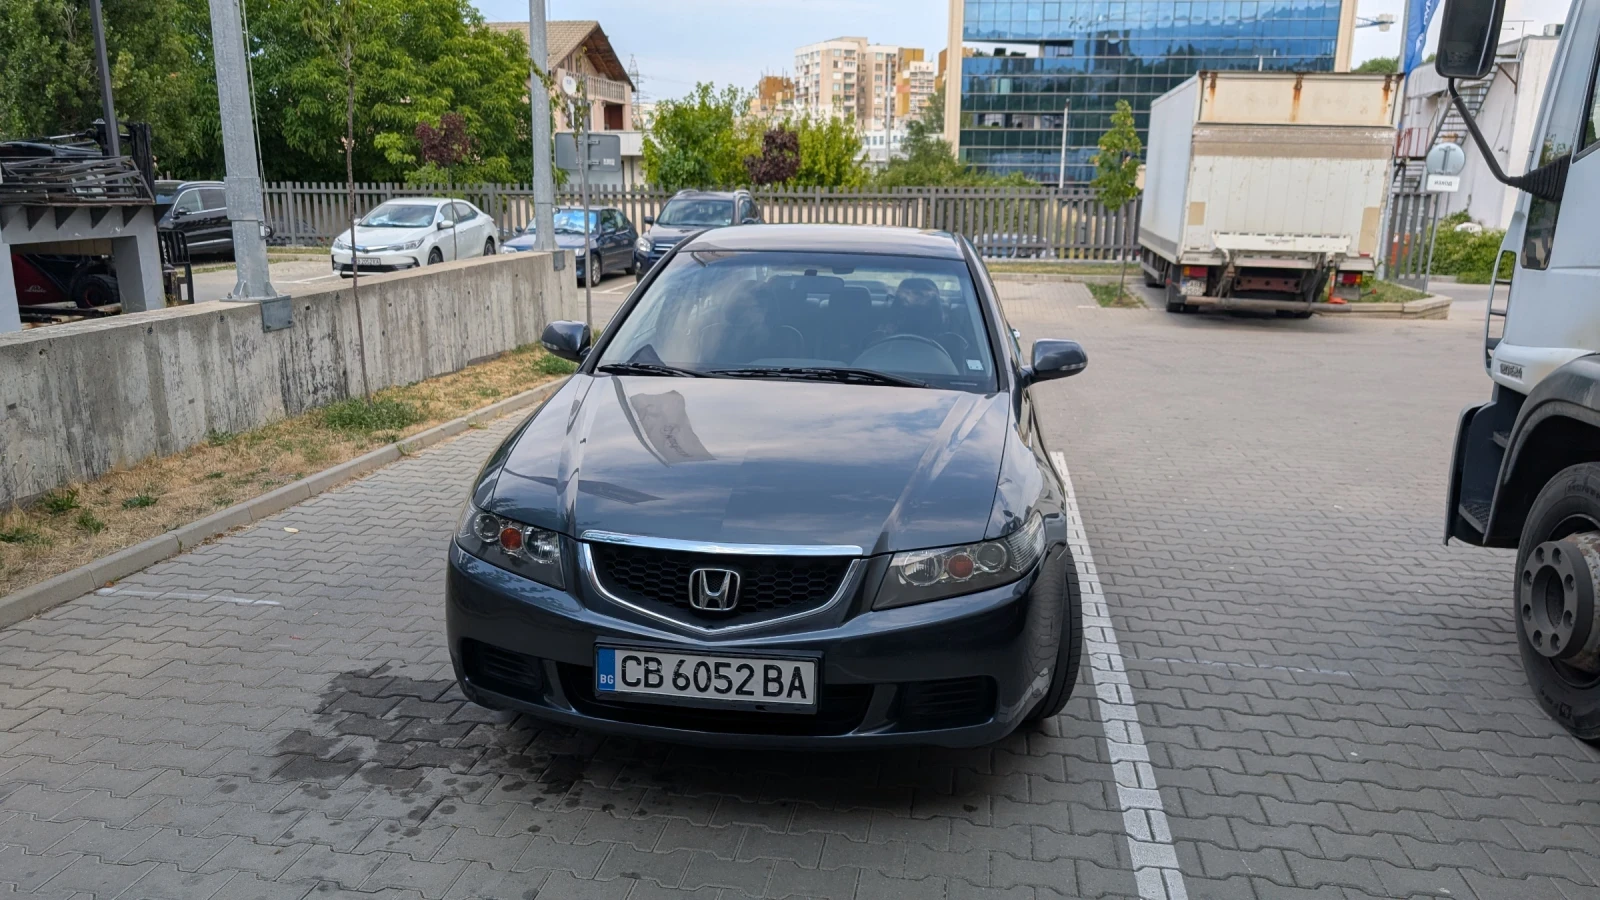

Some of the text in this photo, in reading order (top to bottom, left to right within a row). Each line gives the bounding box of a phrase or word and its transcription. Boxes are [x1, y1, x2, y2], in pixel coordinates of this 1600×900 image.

[600, 674, 614, 685] BG
[621, 655, 807, 699] CB 6052 BA
